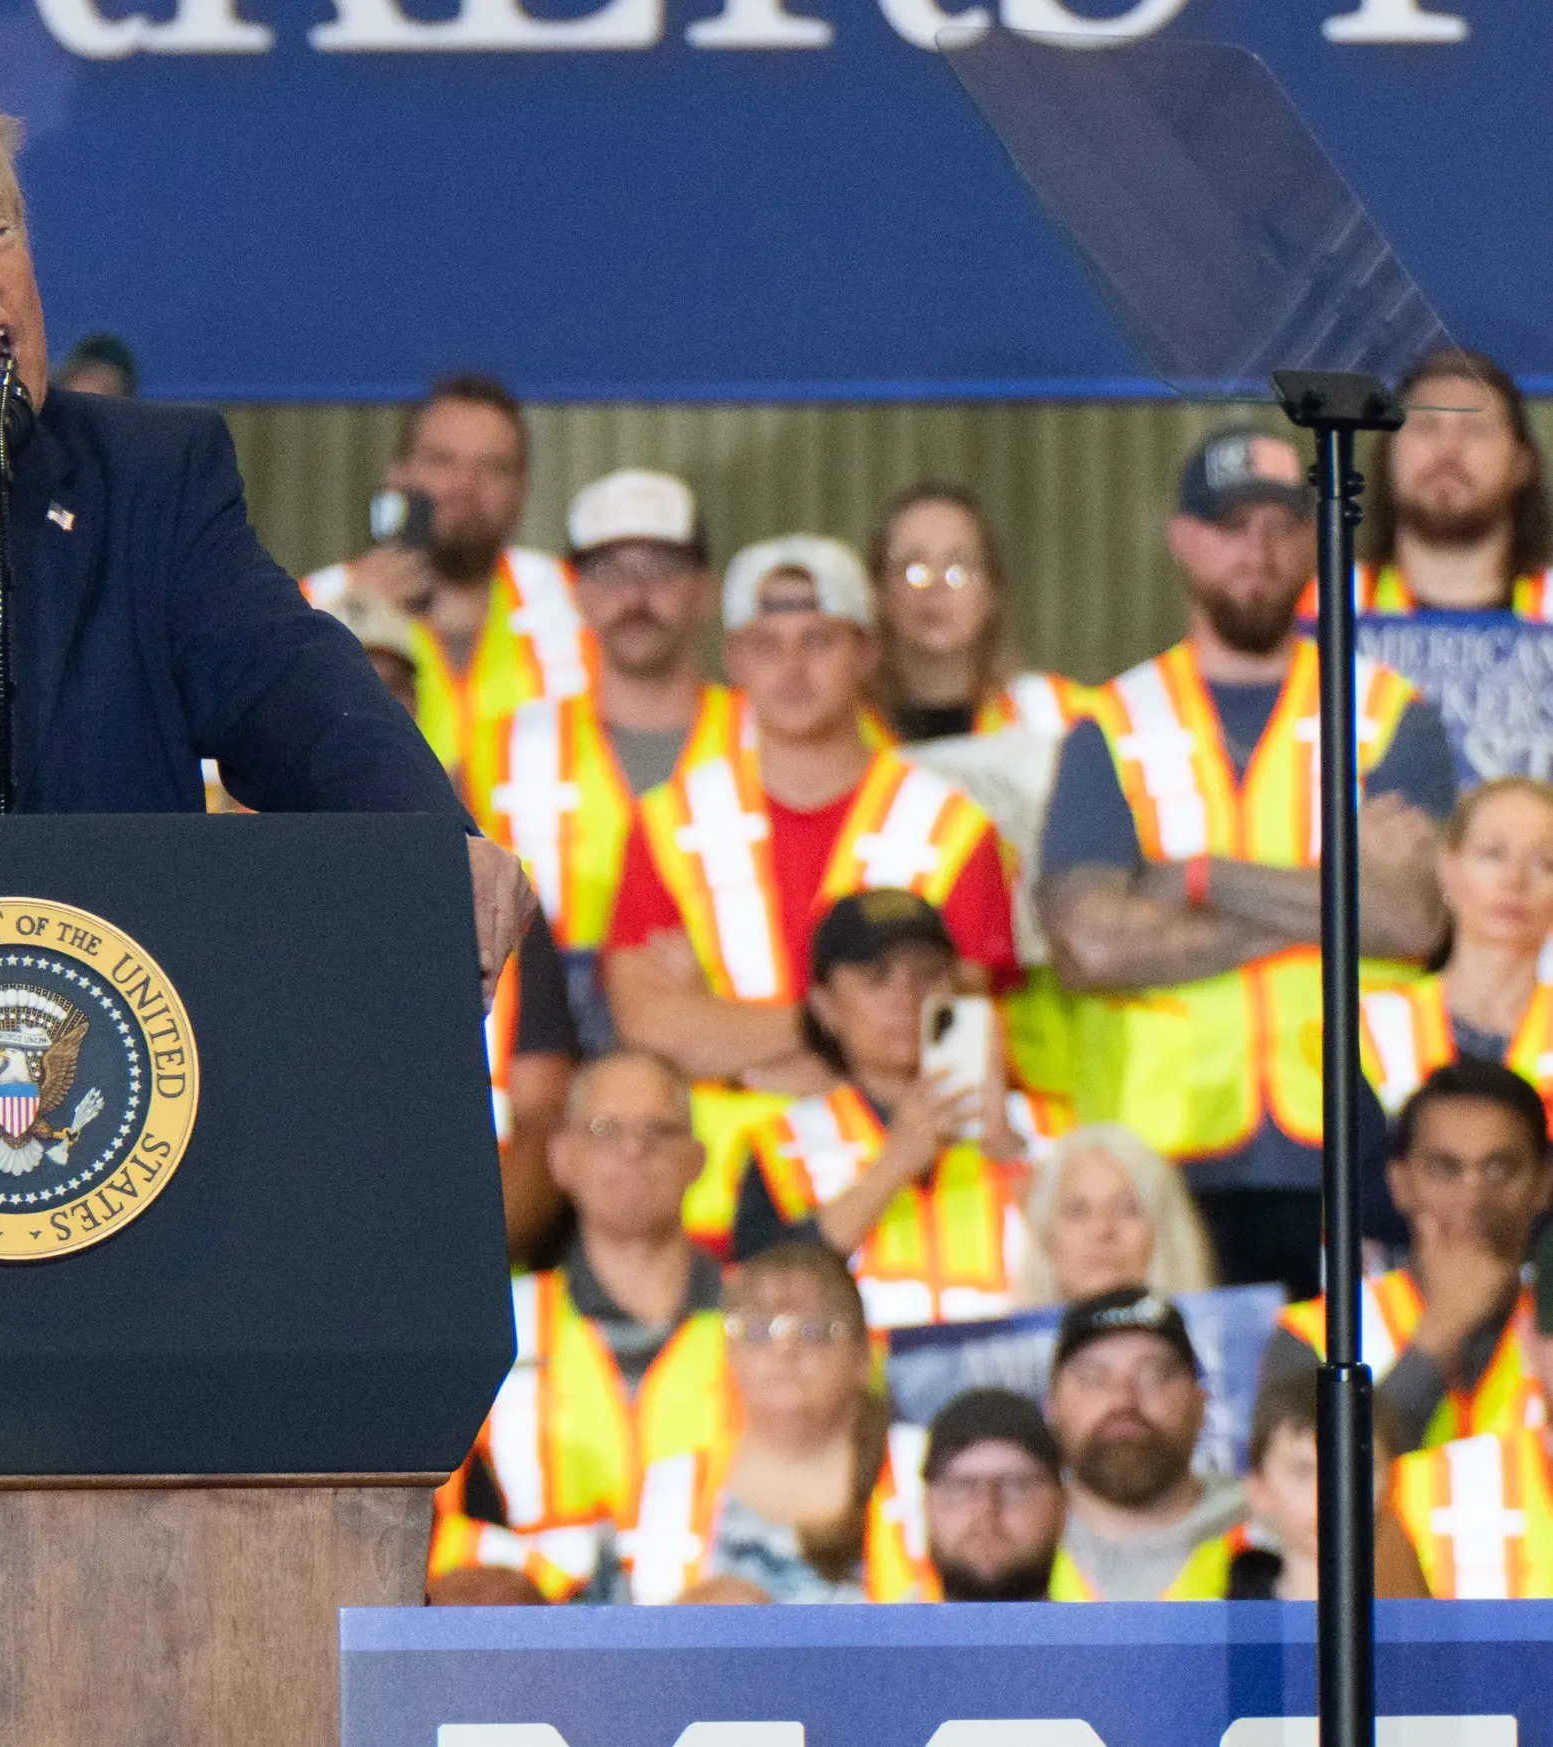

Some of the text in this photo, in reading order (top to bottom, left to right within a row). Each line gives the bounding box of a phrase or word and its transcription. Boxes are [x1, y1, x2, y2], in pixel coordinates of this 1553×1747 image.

[15, 915, 49, 936] OF
[57, 922, 102, 956] THE
[111, 952, 186, 1099] UNITED
[49, 1132, 171, 1241] STATES
